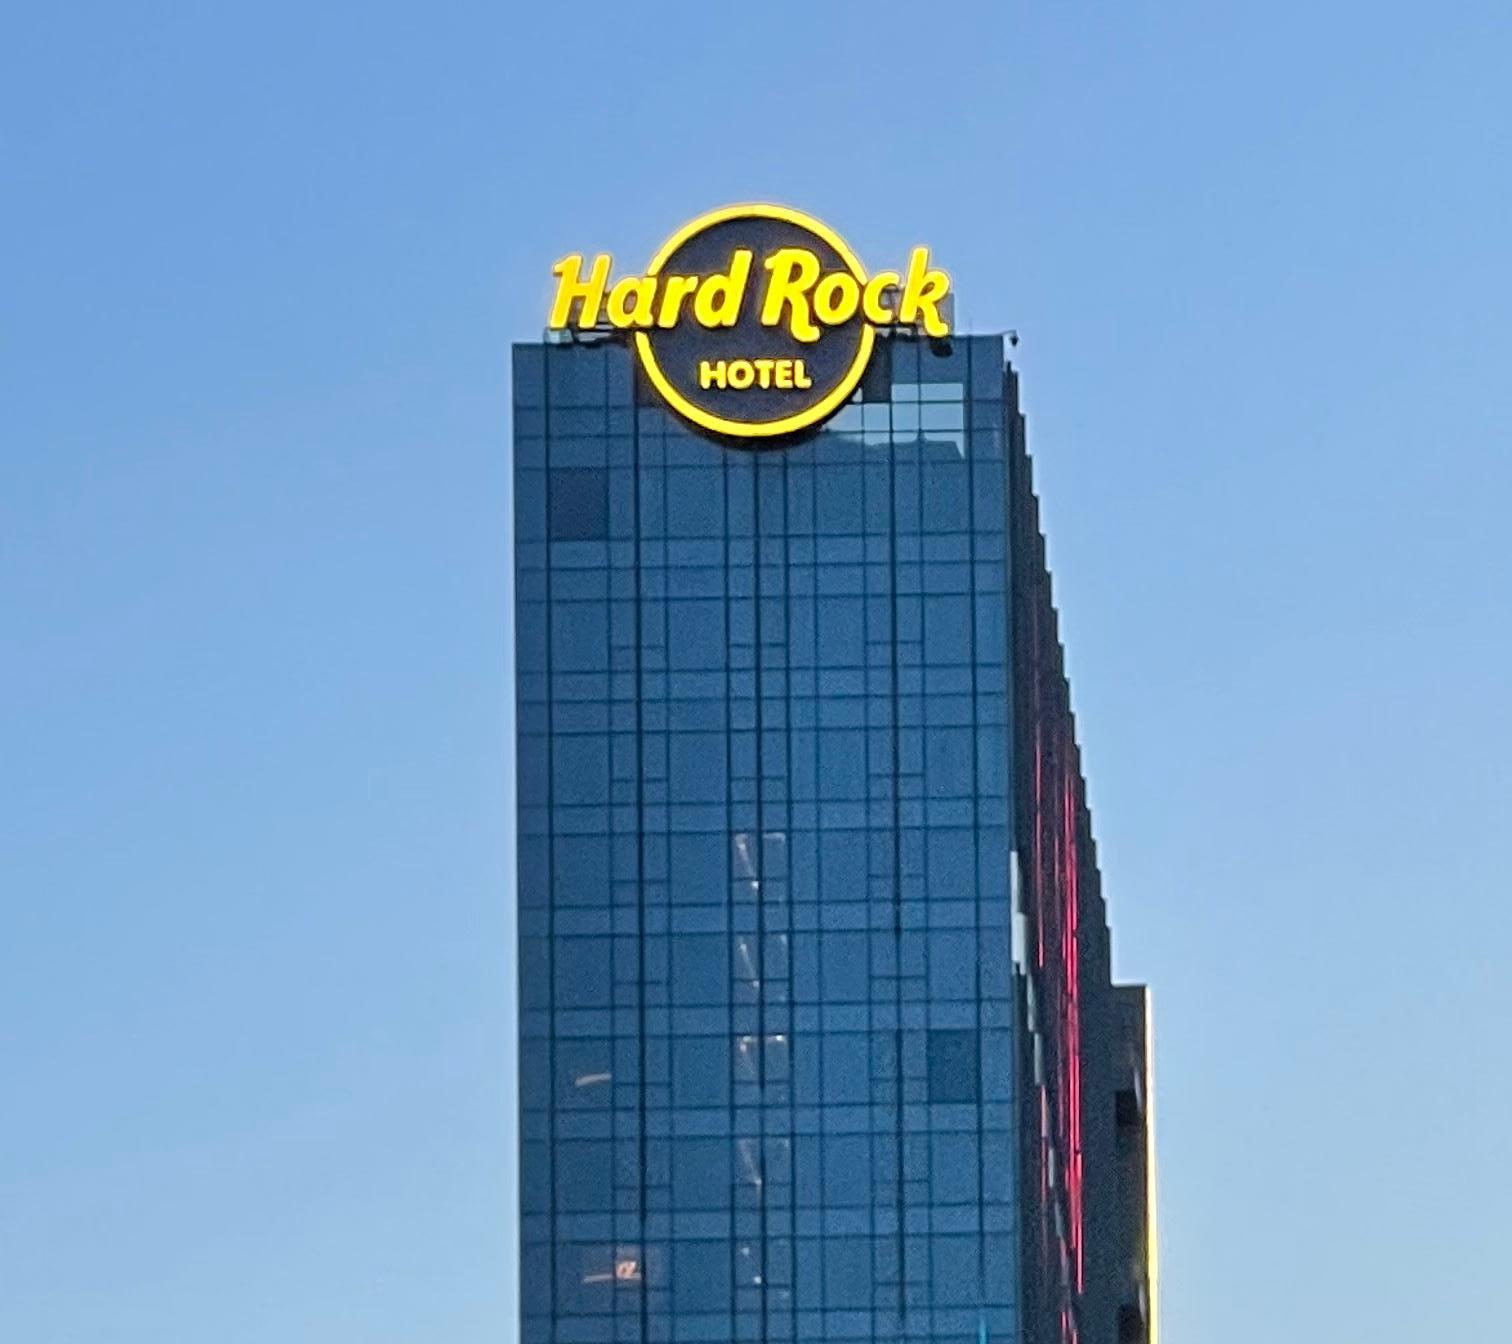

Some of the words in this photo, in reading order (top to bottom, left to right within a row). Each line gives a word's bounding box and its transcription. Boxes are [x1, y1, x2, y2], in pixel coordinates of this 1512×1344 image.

[549, 249, 753, 330] Hard
[761, 246, 951, 342] Rock
[700, 359, 812, 390] HOTEL
